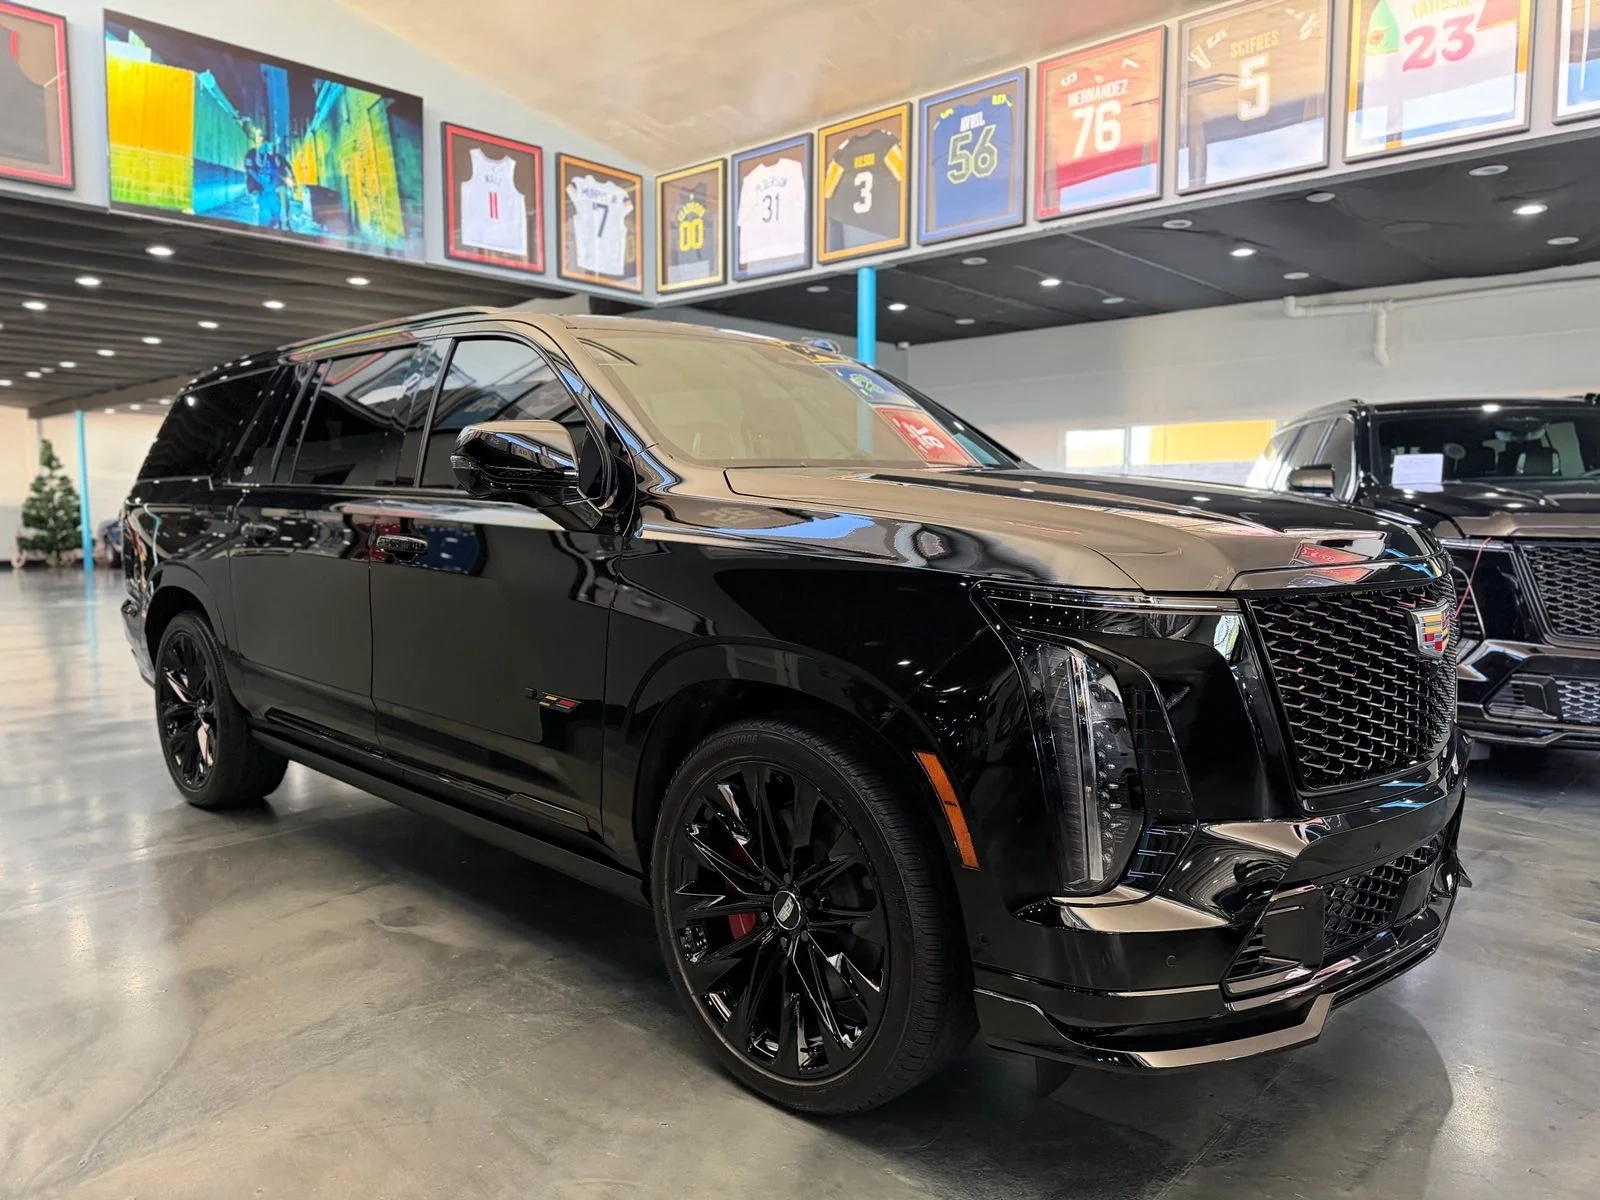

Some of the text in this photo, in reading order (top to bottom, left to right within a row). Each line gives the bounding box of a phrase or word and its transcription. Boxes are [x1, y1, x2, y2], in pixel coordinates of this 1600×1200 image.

[1229, 30, 1279, 58] SCIFRES
[1402, 12, 1475, 72] 23
[1067, 79, 1128, 108] HERNANDEZ
[1236, 52, 1270, 121] 5
[1072, 100, 1121, 159] 76
[947, 124, 997, 184] 56
[488, 191, 499, 220] 11
[762, 192, 780, 223] 31
[853, 170, 873, 214] 3
[591, 201, 609, 238] 7
[679, 218, 704, 252] 00
